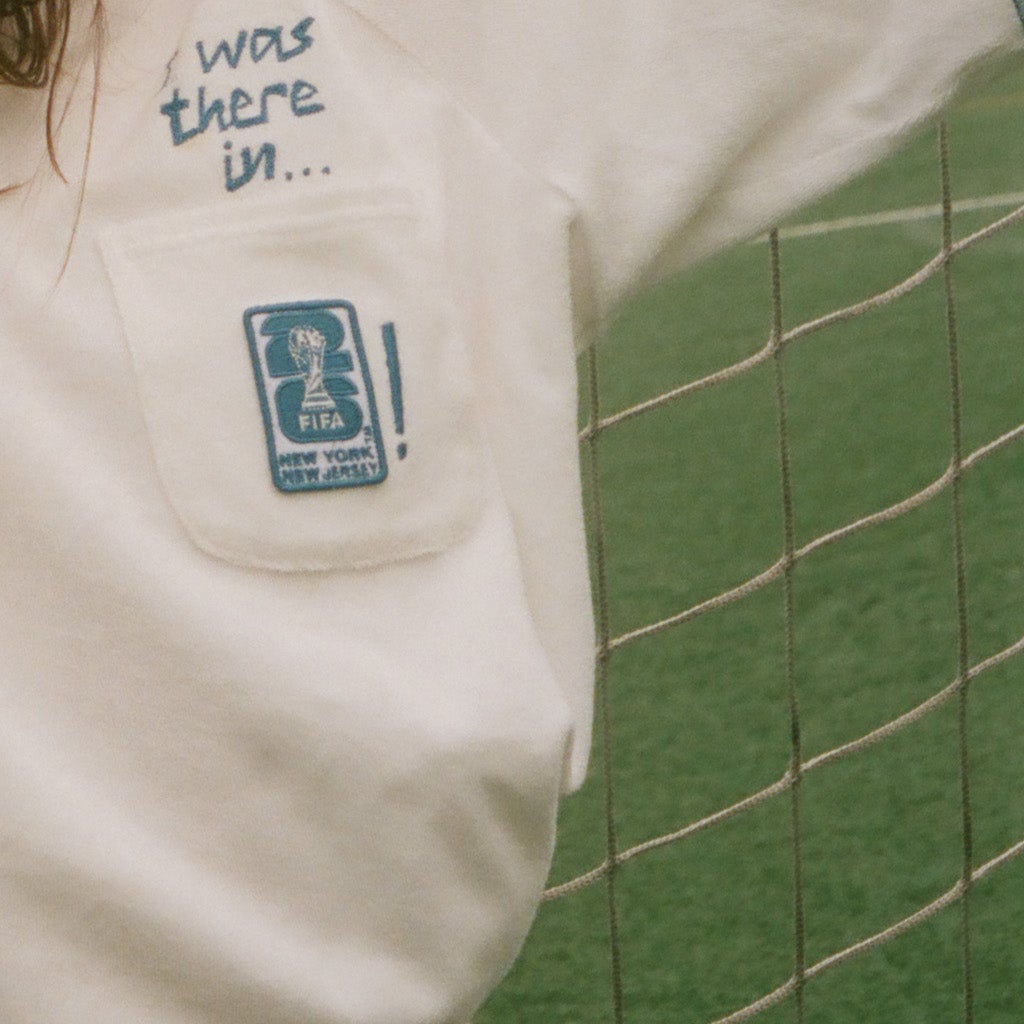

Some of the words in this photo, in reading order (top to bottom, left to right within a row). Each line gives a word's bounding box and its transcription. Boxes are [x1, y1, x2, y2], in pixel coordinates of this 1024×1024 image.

[195, 16, 315, 73] was
[160, 79, 325, 146] there
[223, 140, 331, 192] in...
[298, 412, 345, 432] FIFA
[278, 451, 317, 467] NEW
[323, 446, 375, 464] YORK
[280, 467, 319, 485] NEW
[322, 463, 378, 480] JERSEY
